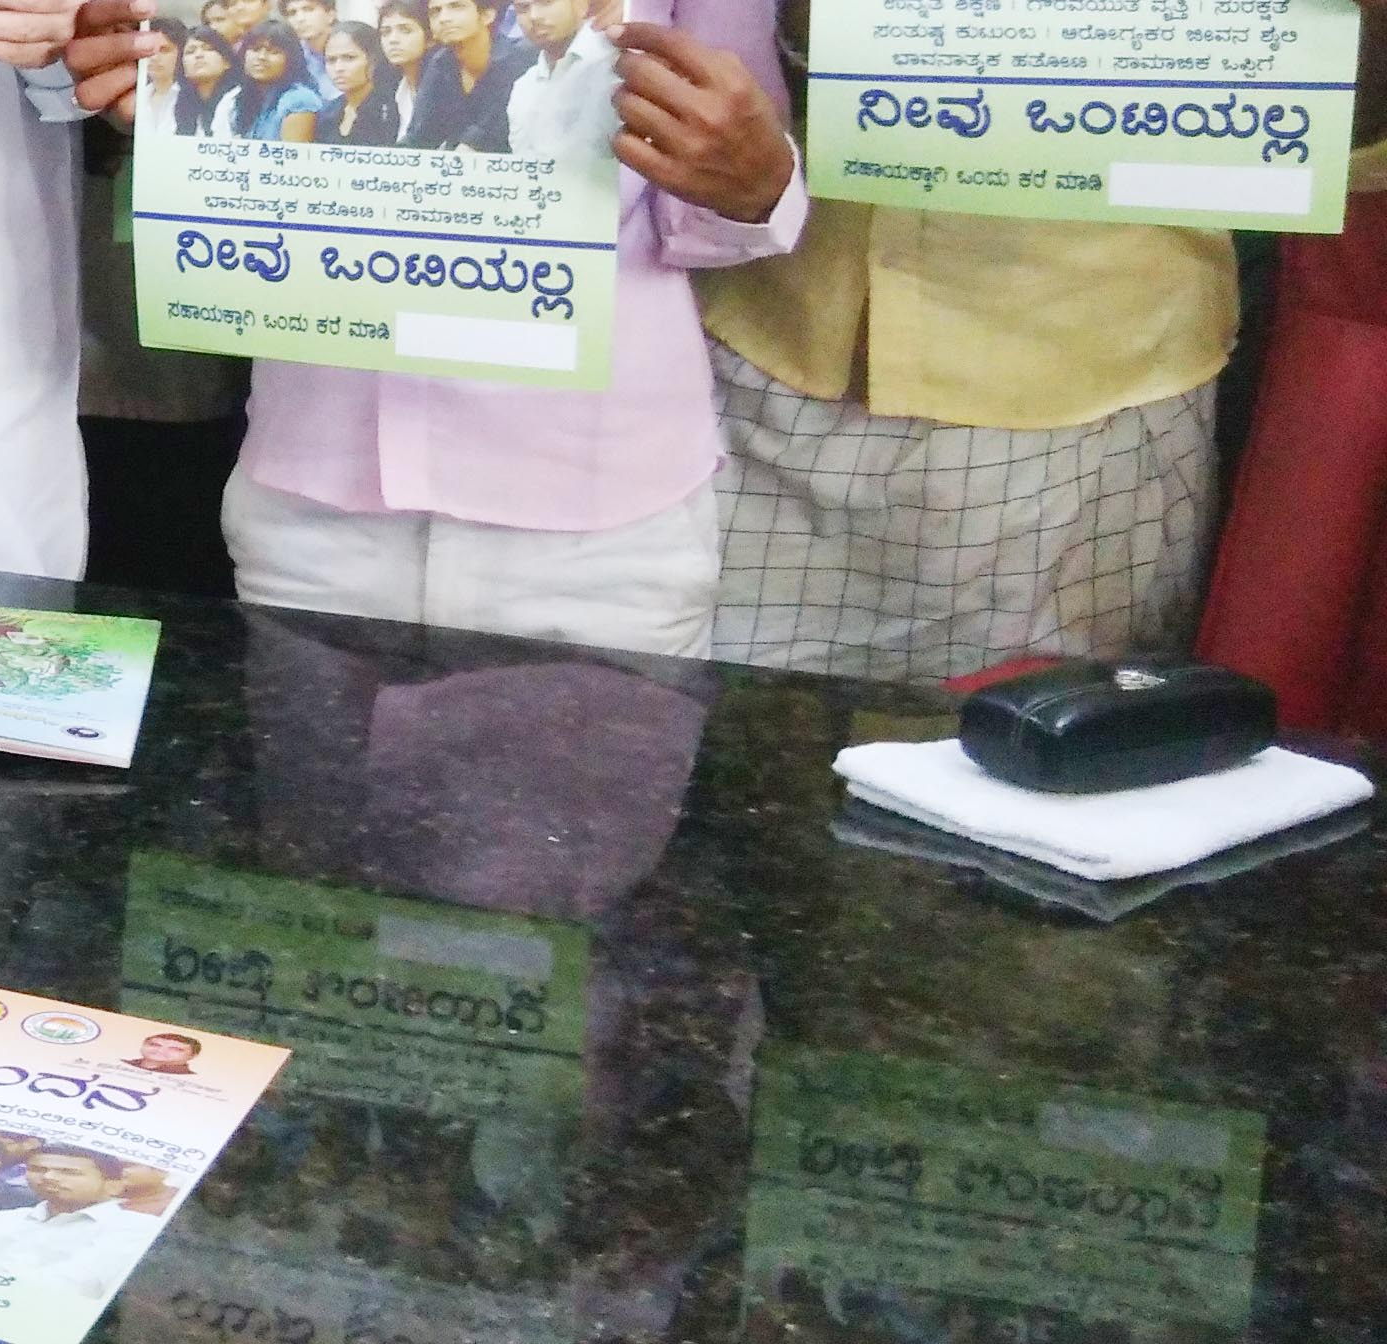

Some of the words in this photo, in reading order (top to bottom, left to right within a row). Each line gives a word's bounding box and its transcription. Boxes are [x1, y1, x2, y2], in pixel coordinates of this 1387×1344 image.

[858, 88, 990, 138] ನೀವು
[1025, 93, 1309, 163] ಒಂಟಿಯಲ್ಲ
[175, 229, 290, 281] ನೀವು
[319, 247, 573, 318] ಒಂಟಿಯಲ್ಲ
